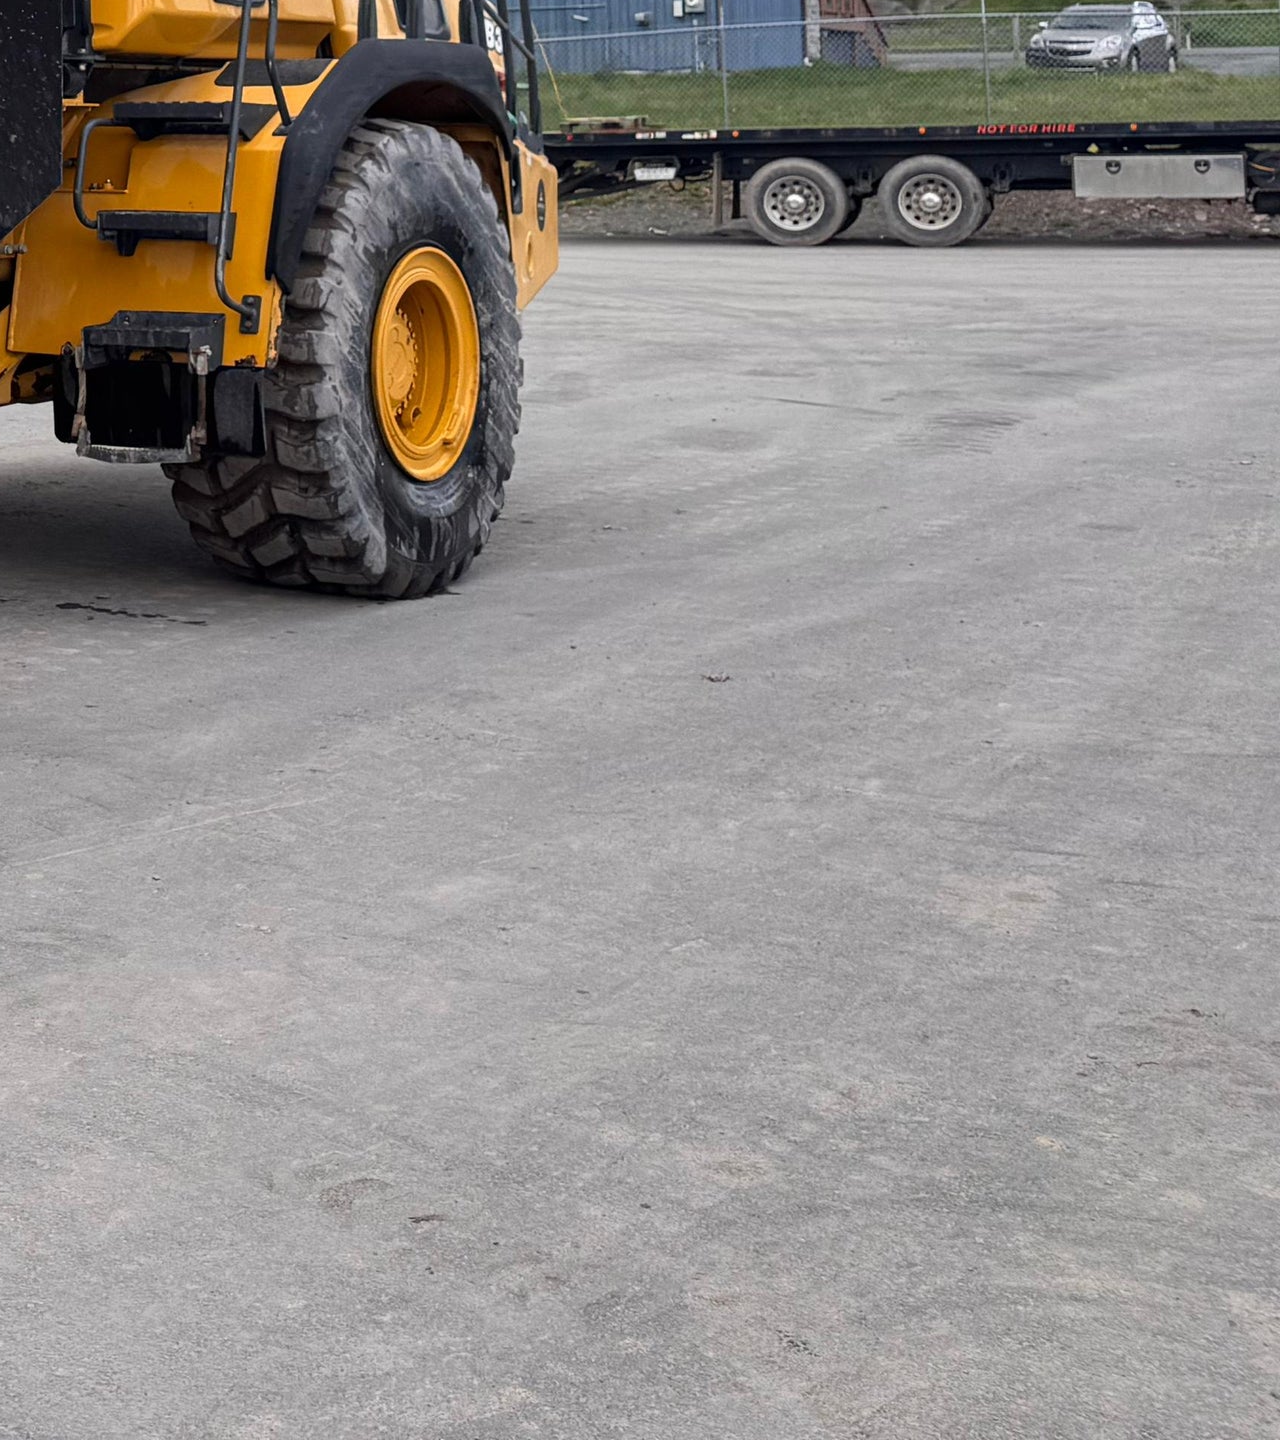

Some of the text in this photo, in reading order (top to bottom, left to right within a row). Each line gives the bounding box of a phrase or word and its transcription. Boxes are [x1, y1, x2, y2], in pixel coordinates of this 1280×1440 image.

[977, 123, 1076, 134] NOT FOR HIRE
